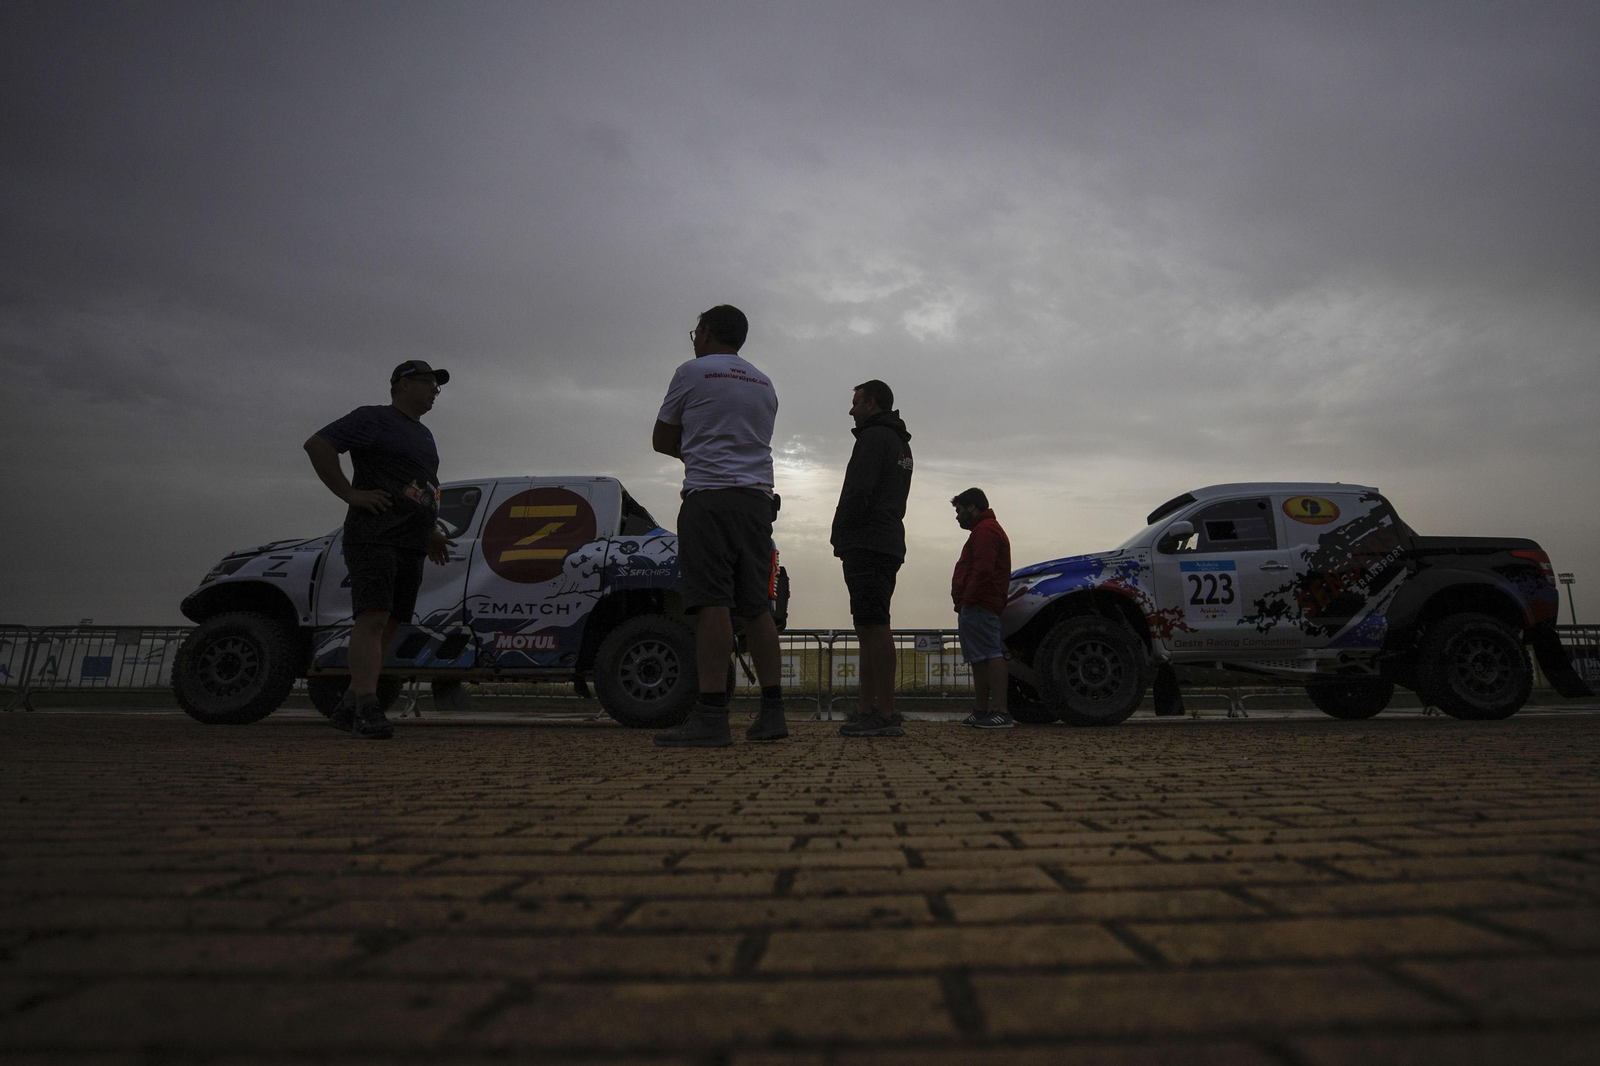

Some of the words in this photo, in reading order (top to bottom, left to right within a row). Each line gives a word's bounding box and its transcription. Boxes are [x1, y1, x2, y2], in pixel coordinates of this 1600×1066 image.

[630, 568, 671, 576] SFICHIPS
[1351, 545, 1405, 593] TRANSPORT
[1187, 573, 1235, 605] 223
[495, 635, 556, 649] MOTUL
[1174, 639, 1203, 648] Oeste
[1206, 638, 1239, 648] Racing
[1242, 637, 1301, 646] Competition
